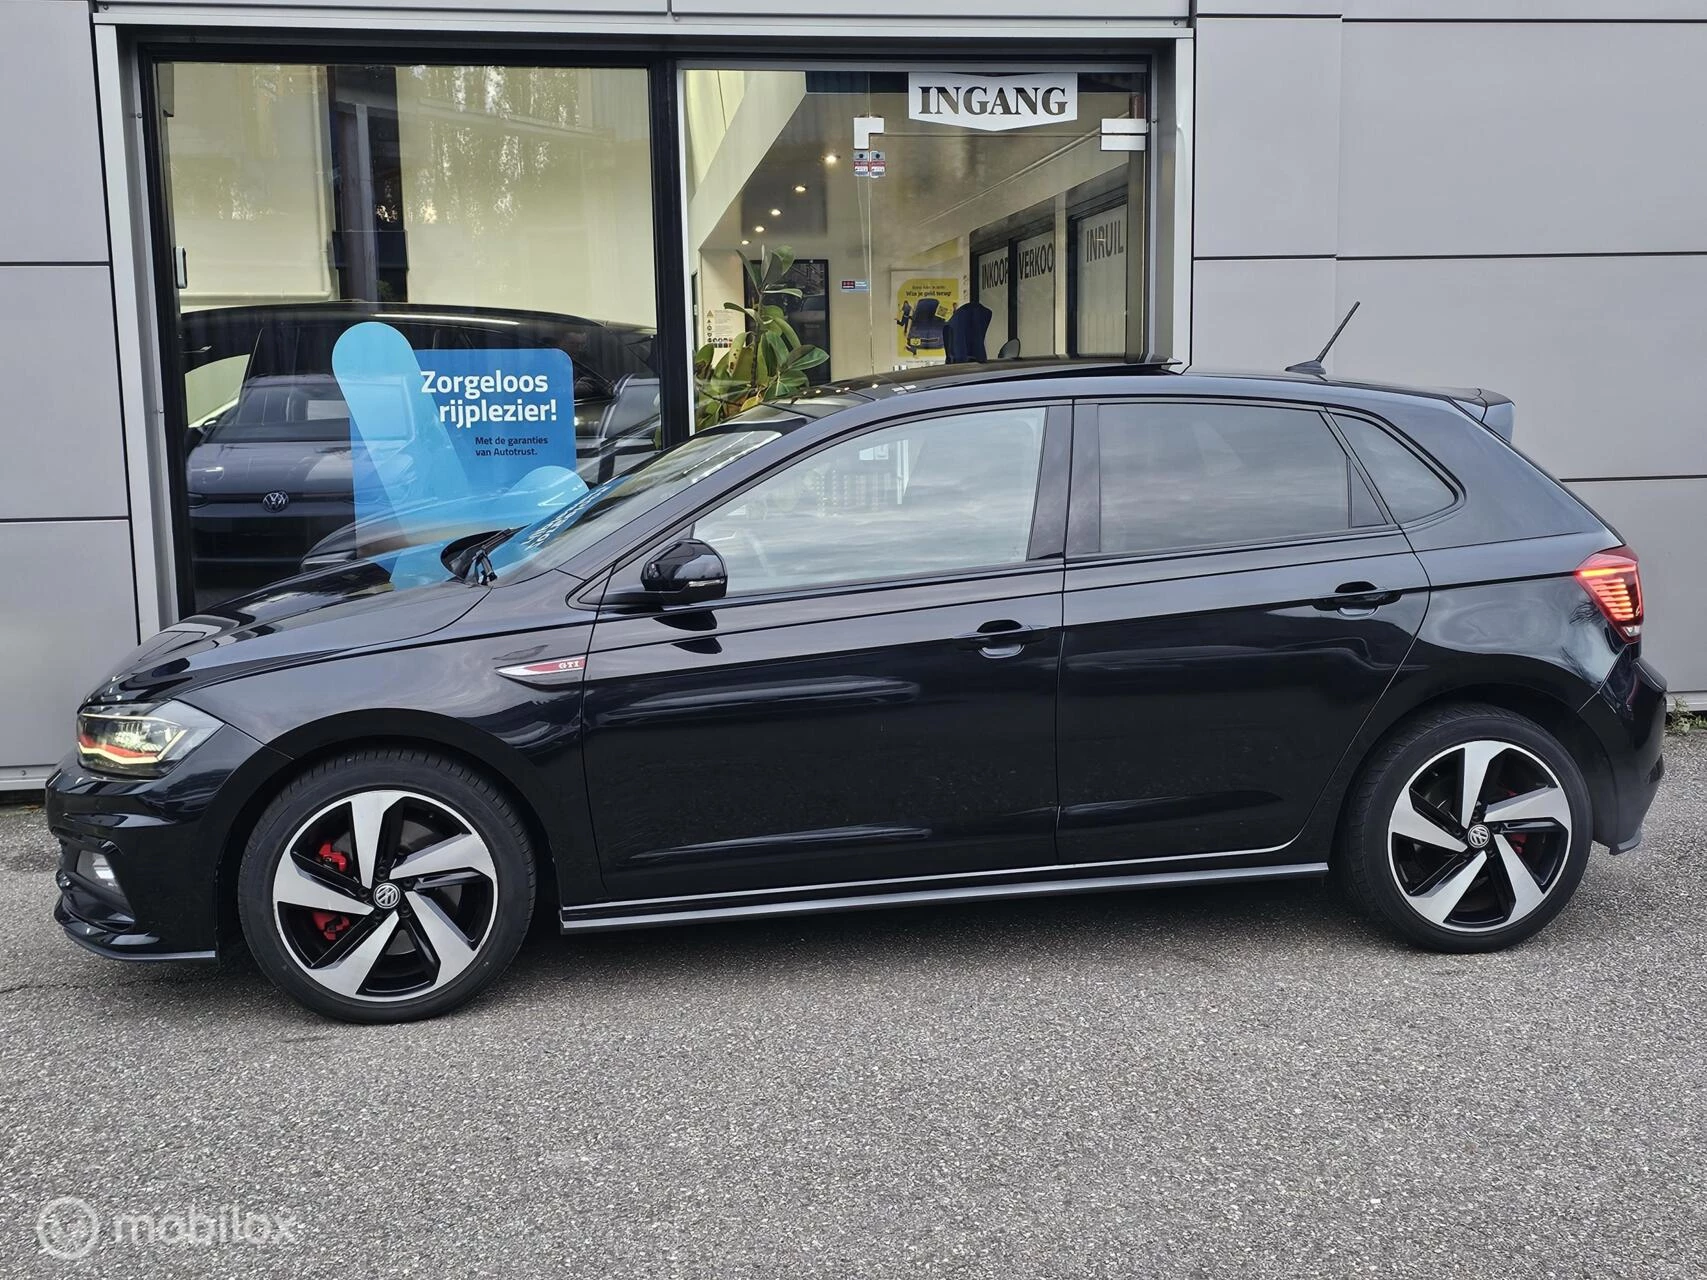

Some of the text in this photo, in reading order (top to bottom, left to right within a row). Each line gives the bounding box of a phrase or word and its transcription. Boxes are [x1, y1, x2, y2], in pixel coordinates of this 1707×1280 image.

[918, 86, 1068, 116] INGANG
[1086, 220, 1124, 263] INRUIL
[1018, 242, 1055, 281] VERKOO
[420, 370, 549, 399] Zorgeloos
[439, 398, 557, 429] rijplezier!
[475, 436, 549, 447] Met de garanties
[475, 447, 538, 457] van Autotrust.
[558, 660, 580, 670] GTI
